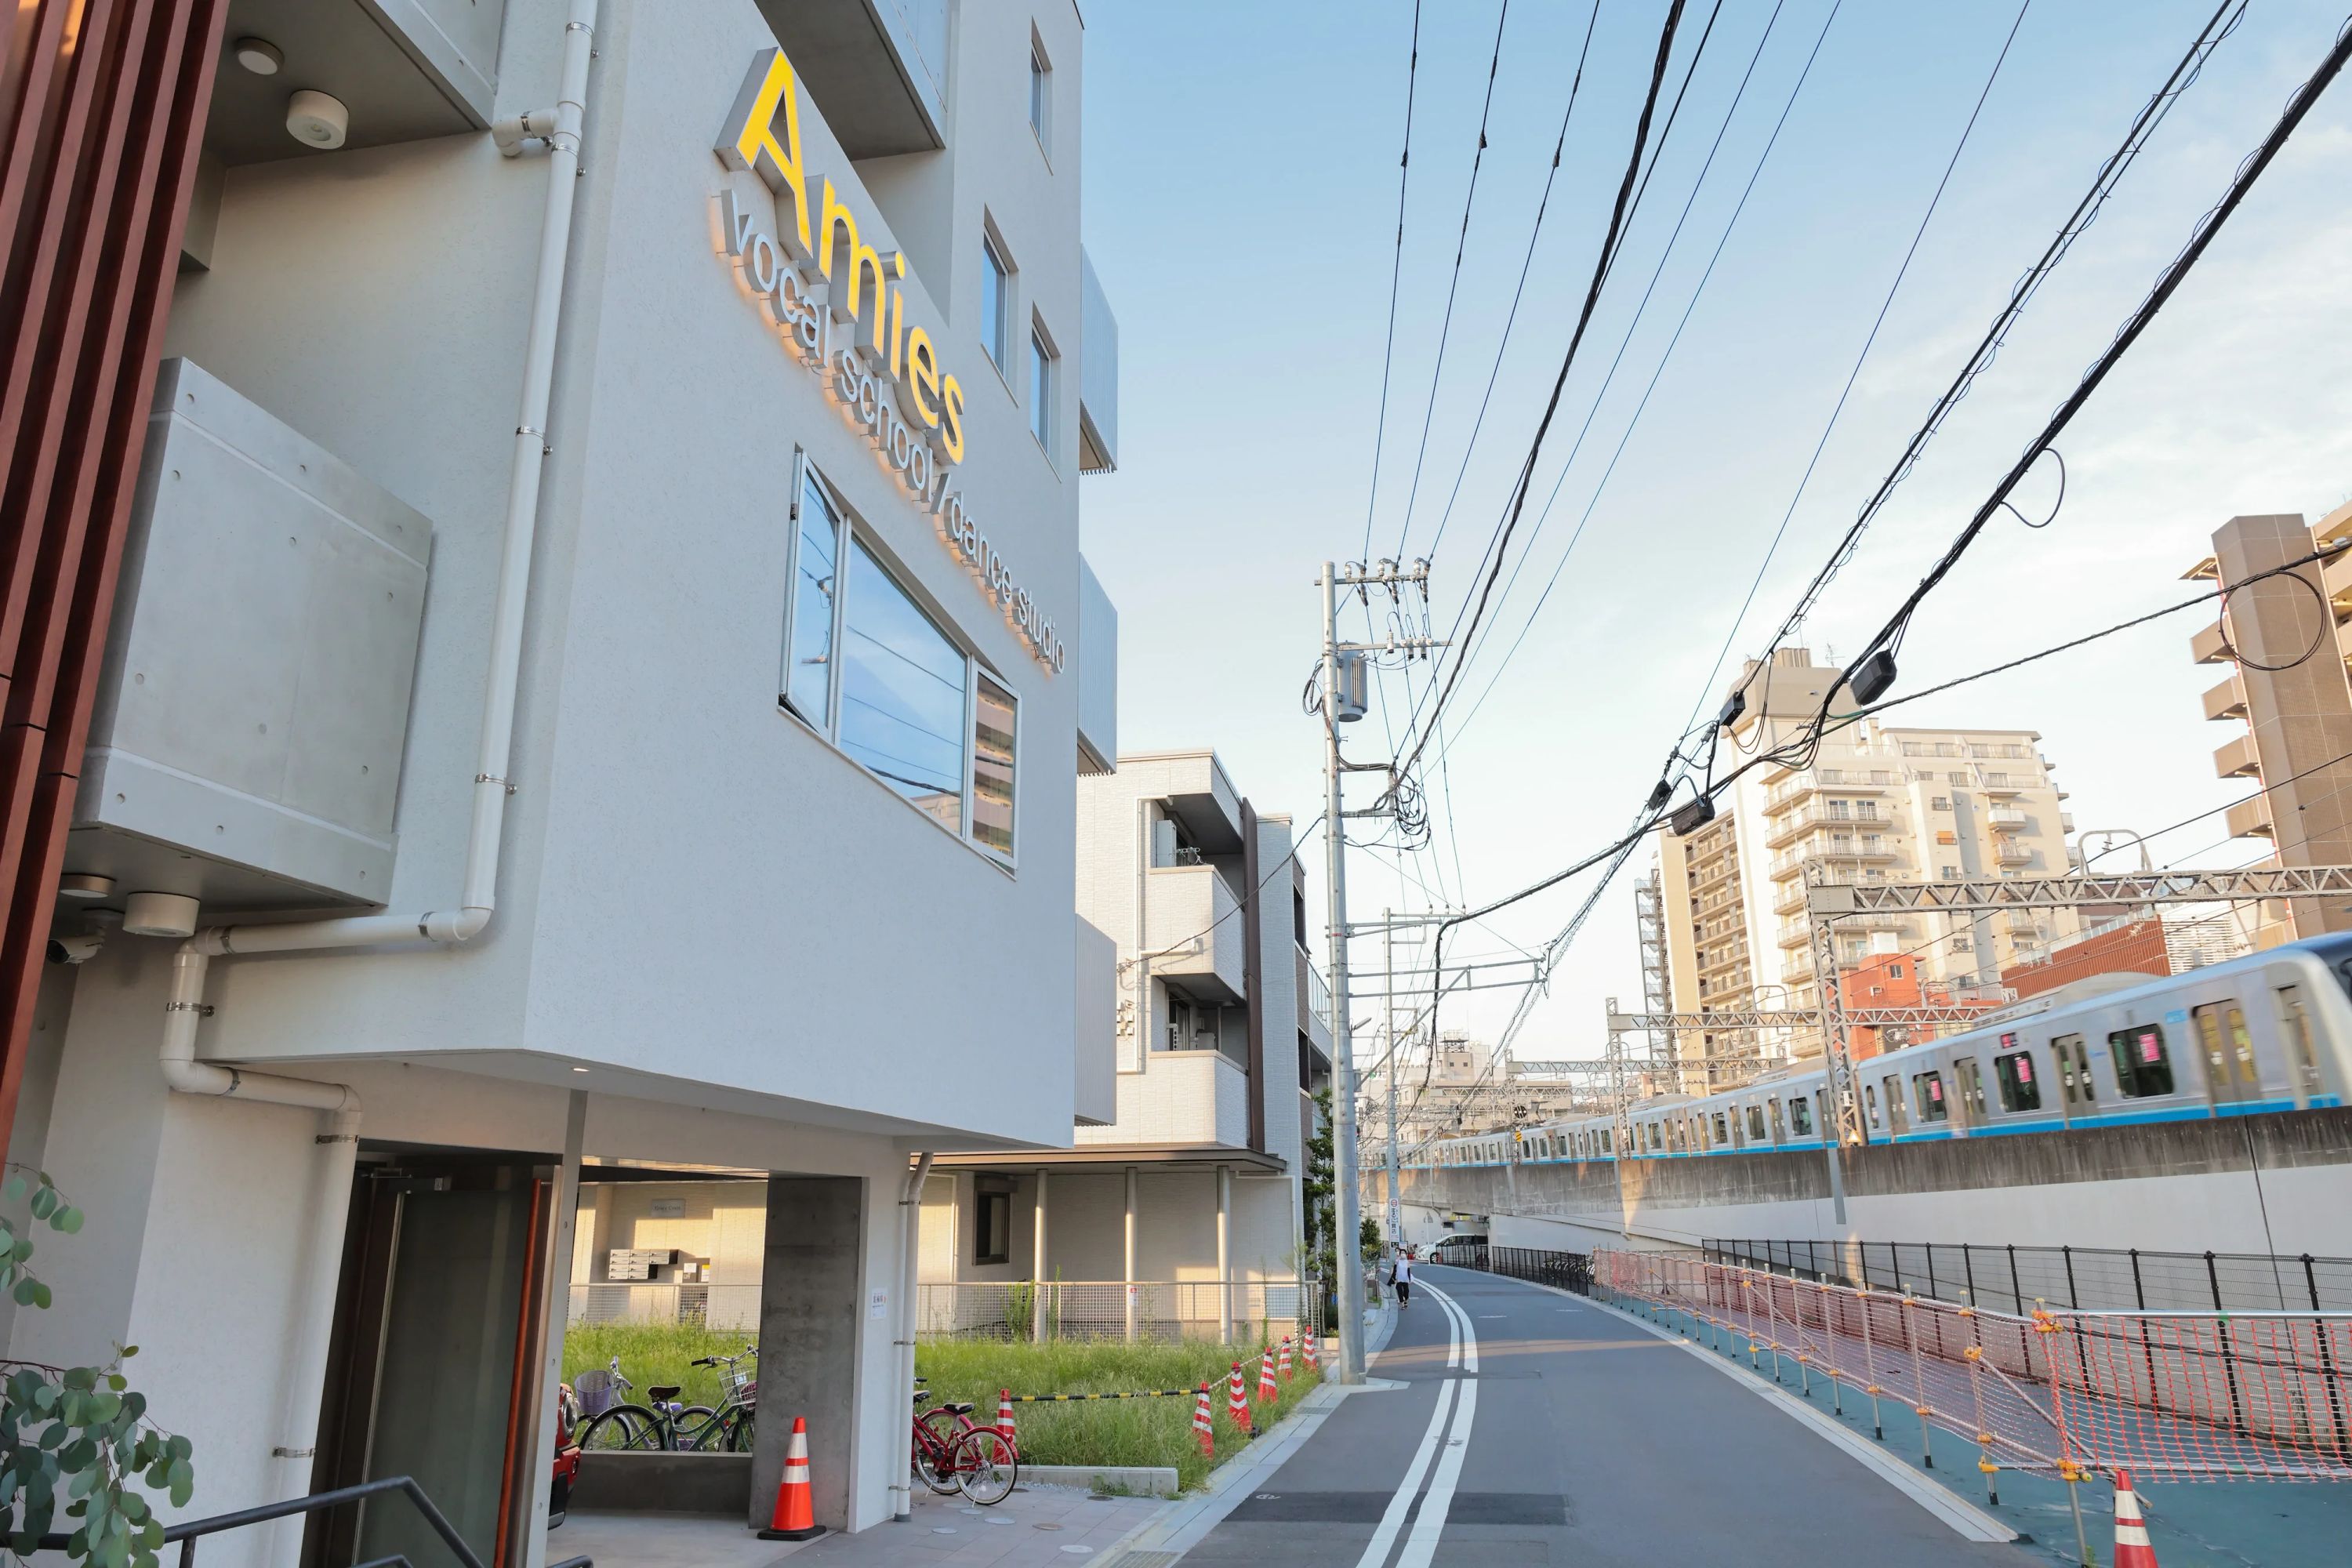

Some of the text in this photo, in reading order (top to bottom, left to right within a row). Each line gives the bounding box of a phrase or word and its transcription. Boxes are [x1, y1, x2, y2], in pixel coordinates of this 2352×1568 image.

[729, 188, 831, 368] vocal
[1018, 587, 1065, 674] studio
[734, 47, 964, 466] Amies
